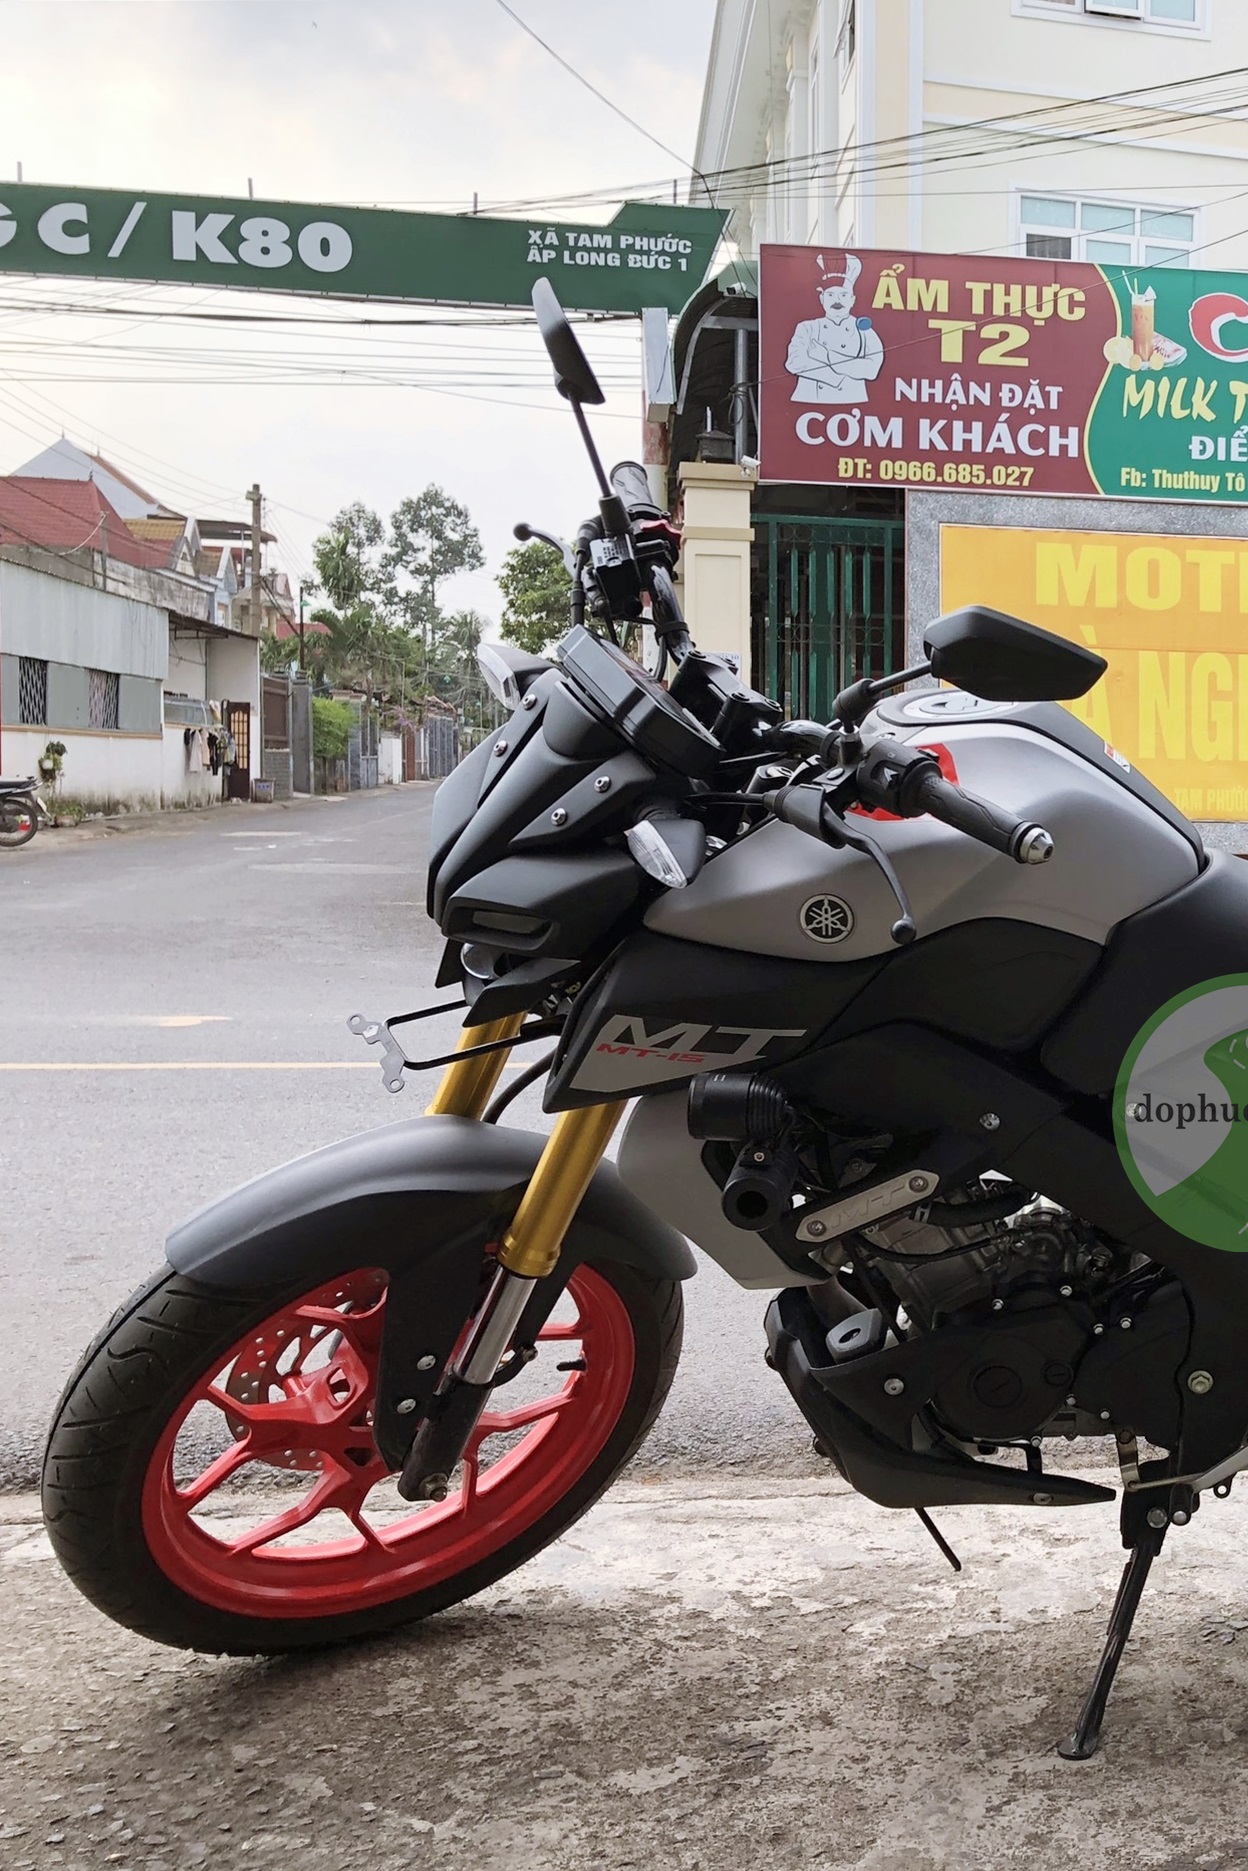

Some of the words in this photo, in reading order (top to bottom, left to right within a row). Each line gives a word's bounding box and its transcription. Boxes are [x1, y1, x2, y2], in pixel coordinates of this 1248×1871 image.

[528, 227, 559, 246] XÃ
[566, 232, 612, 248] TAM
[620, 233, 692, 254] PHƯỚC
[527, 244, 556, 264] ẤP
[563, 250, 620, 267] LONG
[627, 251, 671, 270] ĐỨC
[678, 258, 687, 271] 1
[871, 263, 949, 313] ẨM
[965, 281, 1086, 326] THỰC
[928, 318, 1031, 367] T2
[894, 372, 990, 411] NHẬN
[999, 379, 1063, 415] ĐẶT
[1122, 373, 1218, 422] MILK
[795, 409, 903, 449] CƠM
[918, 412, 1079, 458] KHÁCH
[838, 457, 872, 480] ĐT:
[879, 459, 1034, 487] 0966.685.027
[1120, 467, 1147, 489] Fb:
[1151, 467, 1221, 494] Thuthuy
[1223, 469, 1246, 493] Tô
[1173, 787, 1203, 812] TAM
[596, 1043, 706, 1063] MT-15
